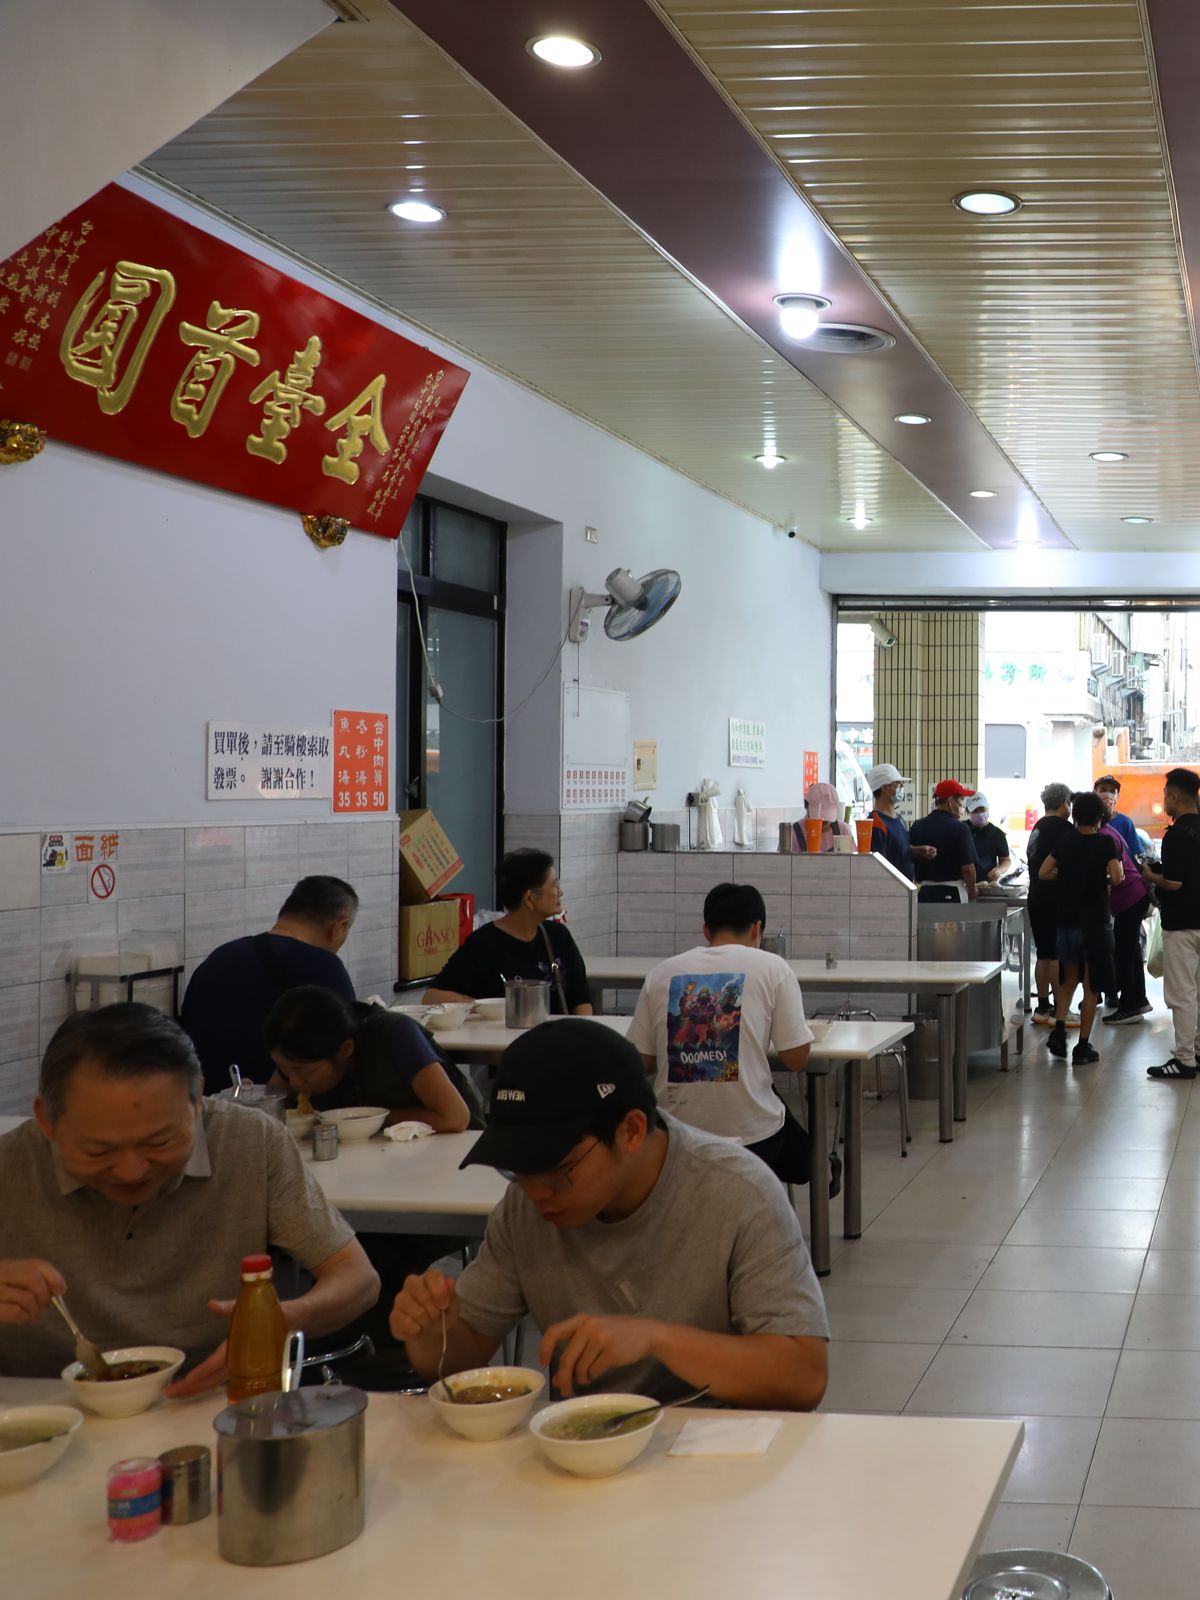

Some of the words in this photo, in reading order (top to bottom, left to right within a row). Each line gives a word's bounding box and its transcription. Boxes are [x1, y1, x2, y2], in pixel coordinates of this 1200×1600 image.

[338, 791, 350, 807] 35
[355, 791, 368, 807] 35
[373, 791, 385, 807] 50
[416, 923, 455, 949] GANSO
[680, 1050, 728, 1065] DOOMED!
